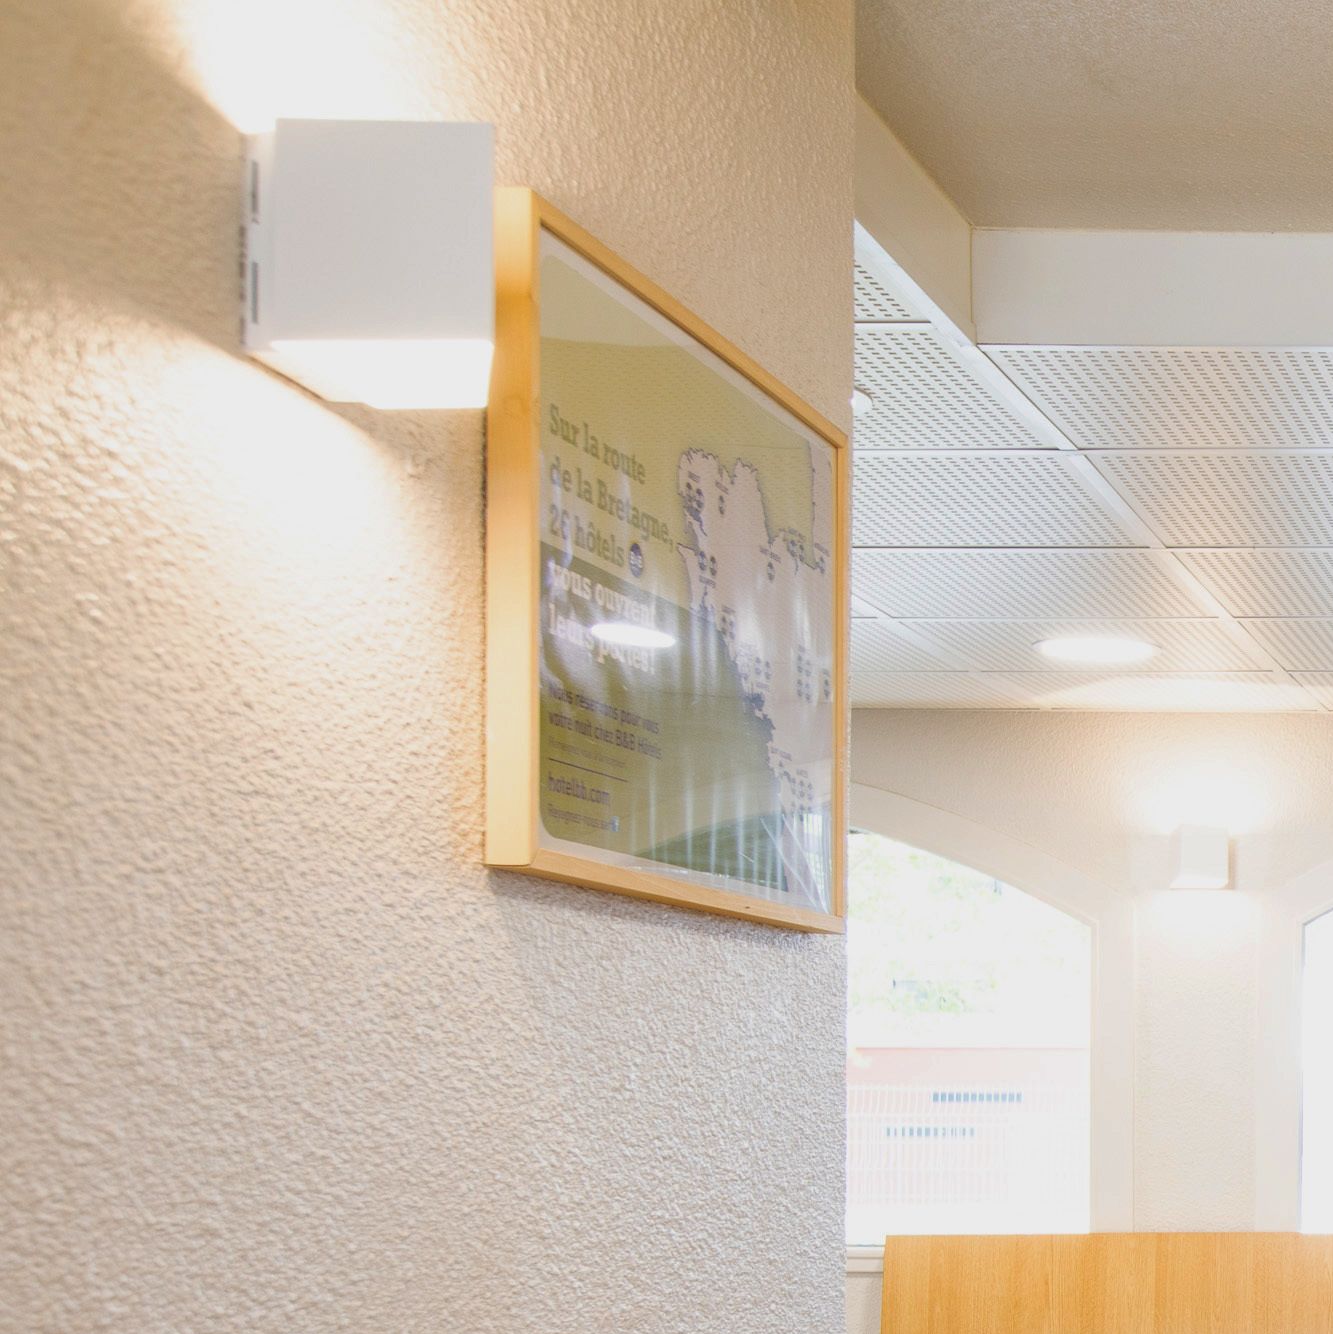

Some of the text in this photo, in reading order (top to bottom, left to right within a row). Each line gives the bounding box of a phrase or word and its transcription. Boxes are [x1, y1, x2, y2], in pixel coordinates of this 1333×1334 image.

[550, 403, 647, 485] Sur la route
[551, 455, 573, 493] de
[577, 467, 594, 506] la
[574, 514, 625, 568] hôtels
